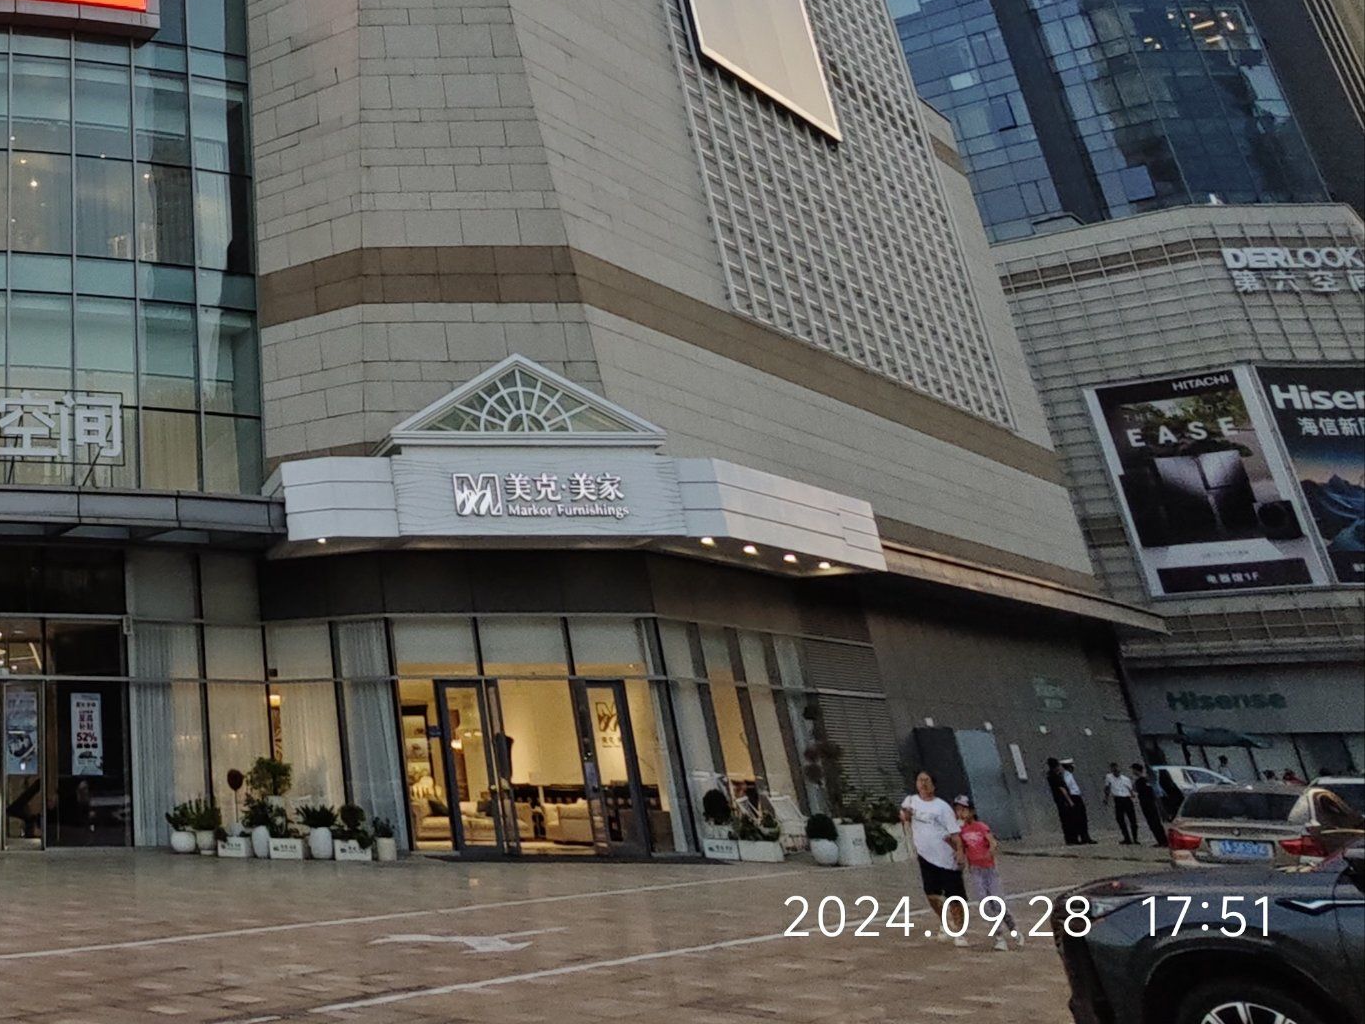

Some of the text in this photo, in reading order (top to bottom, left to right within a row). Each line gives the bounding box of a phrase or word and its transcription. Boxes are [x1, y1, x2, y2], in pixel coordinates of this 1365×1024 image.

[1221, 247, 1365, 268] DERLOOK
[1172, 374, 1230, 391] HITACHI
[1126, 417, 1239, 447] EASE
[508, 504, 630, 519] Markor Furnishings
[77, 732, 97, 742] 52%
